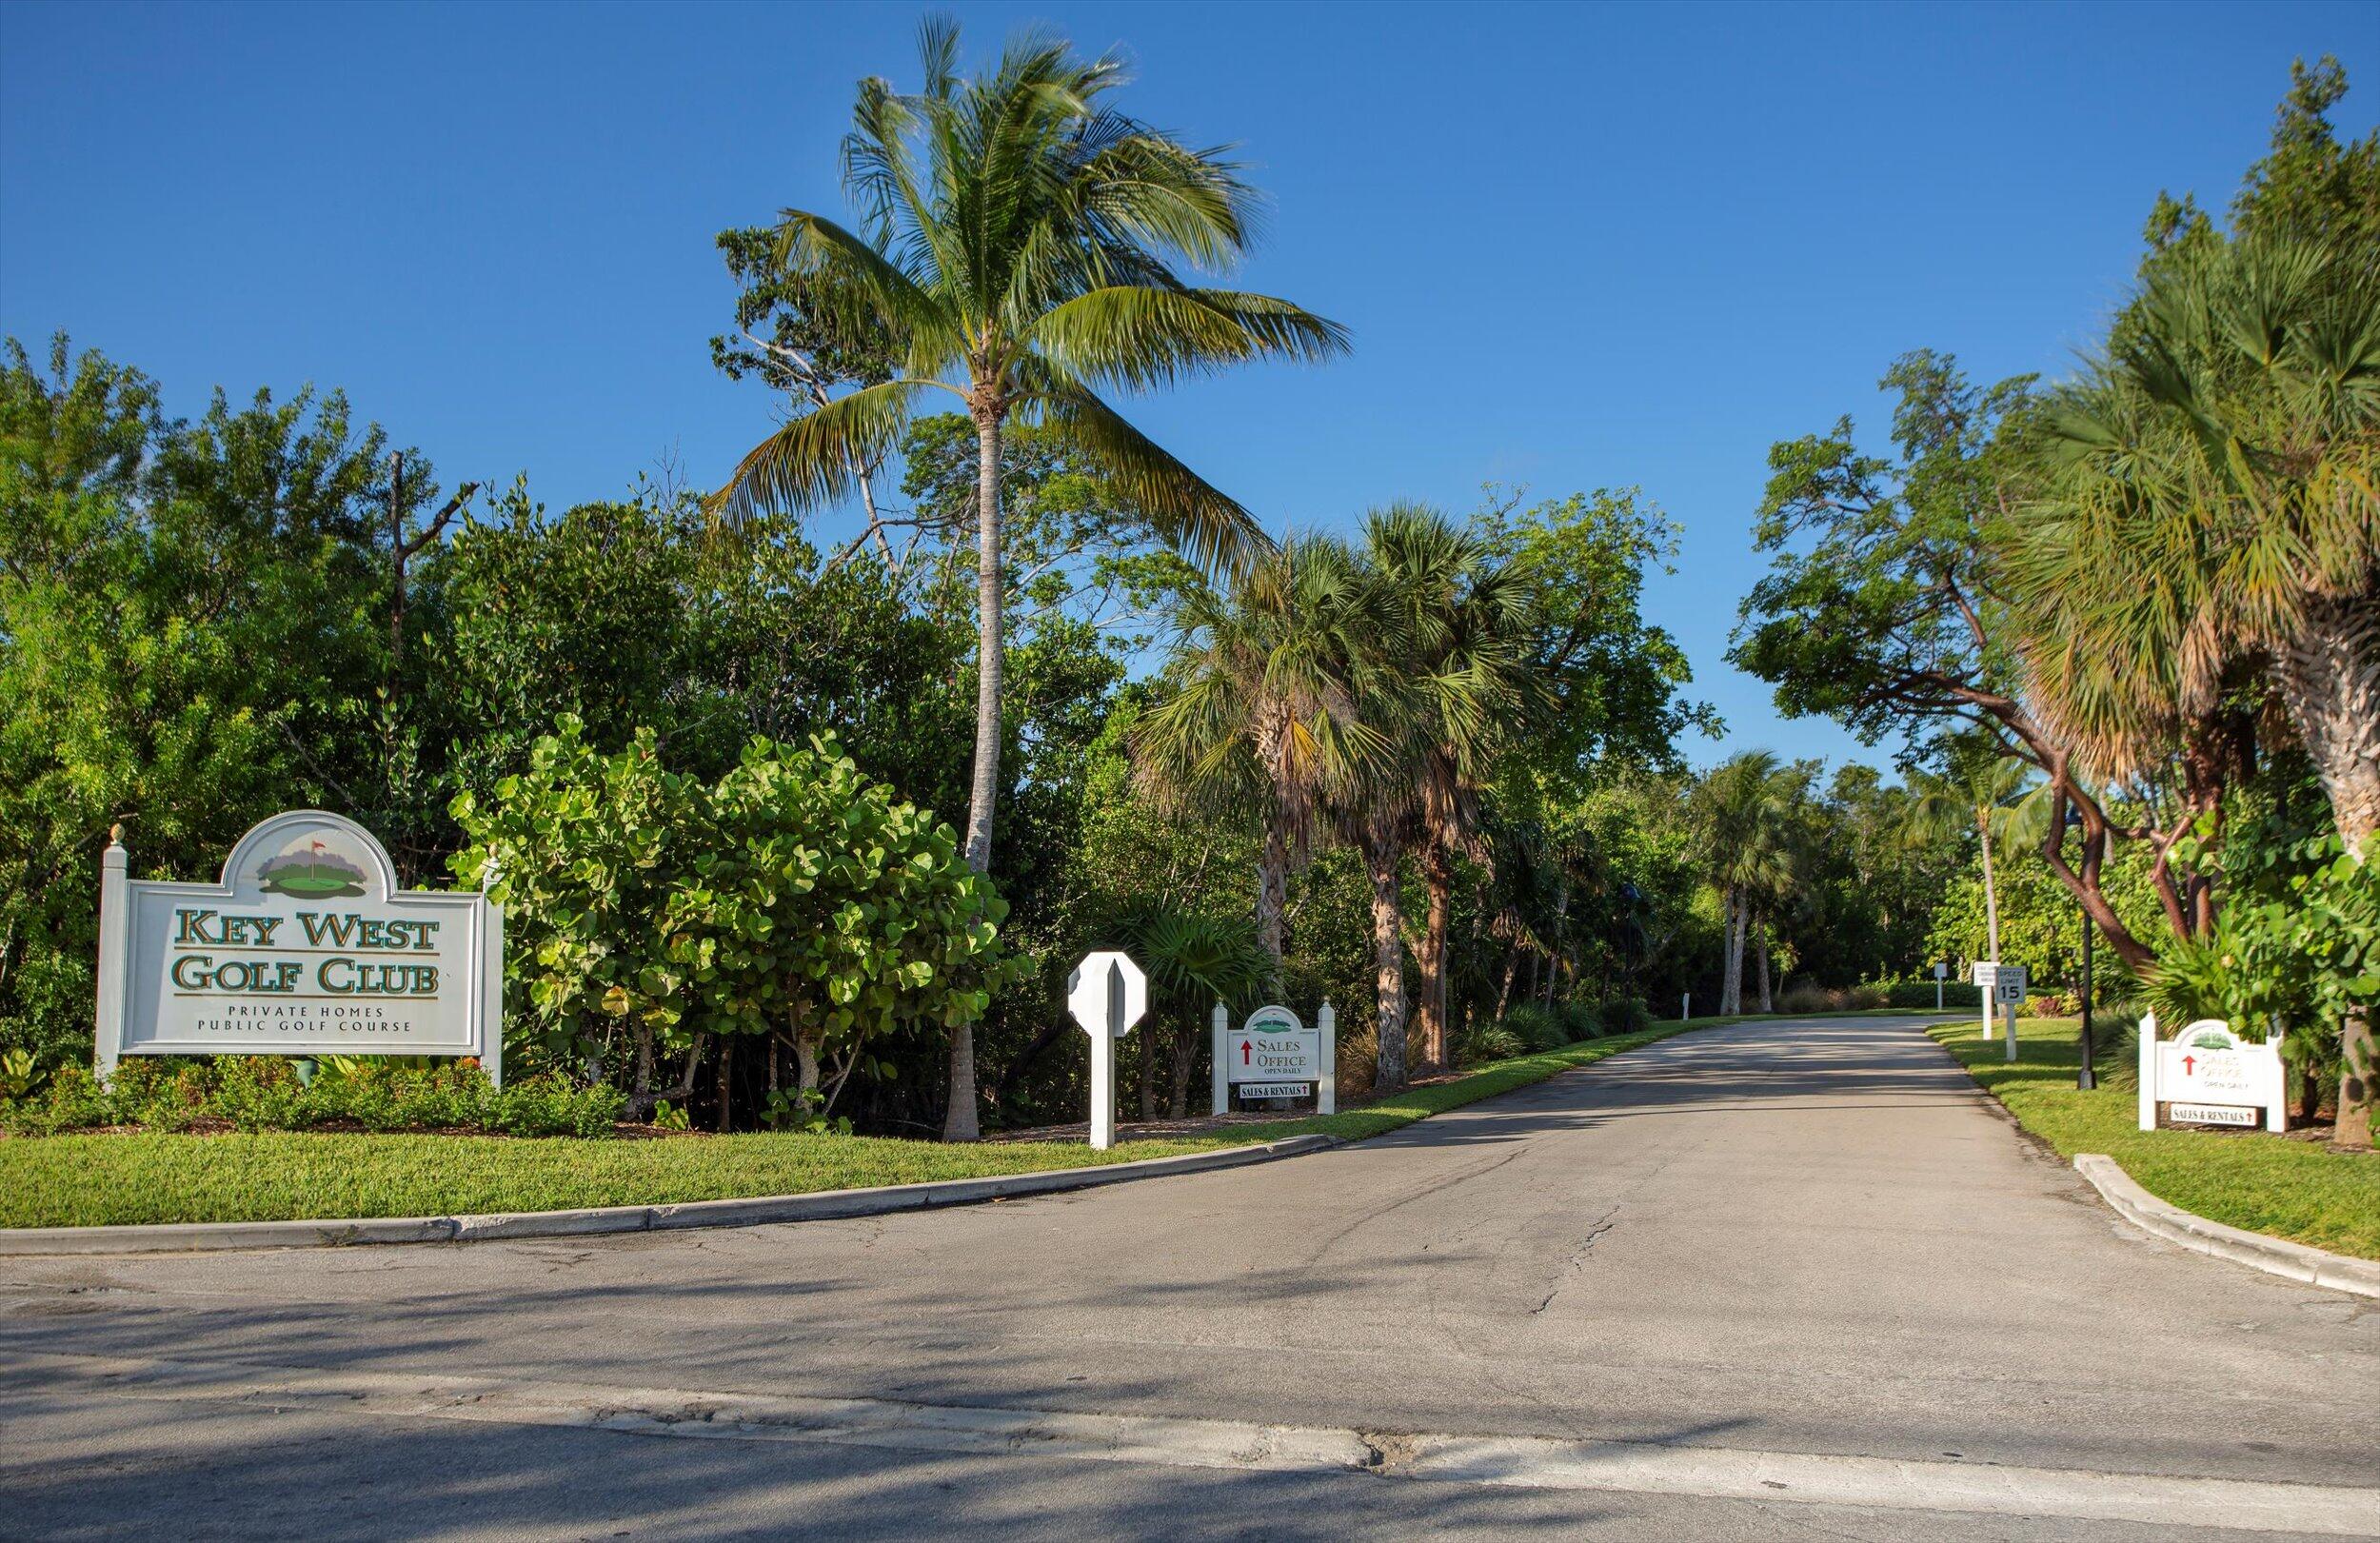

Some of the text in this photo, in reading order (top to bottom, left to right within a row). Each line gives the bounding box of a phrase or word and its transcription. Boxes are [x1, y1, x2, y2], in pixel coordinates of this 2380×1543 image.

[173, 909, 440, 950] KEY WEST
[171, 955, 440, 995] GOLF CLUB
[2001, 985, 2019, 999] 15
[228, 1006, 384, 1018] PRIVATE HOMES
[198, 1020, 411, 1033] PUBLIC GOLF COURSE
[1258, 1039, 1300, 1051] SALES
[1258, 1055, 1306, 1066] OFFICE
[1241, 1086, 1301, 1097] SALES & RENTALS
[2173, 1109, 2245, 1122] SALES & RENTALS
